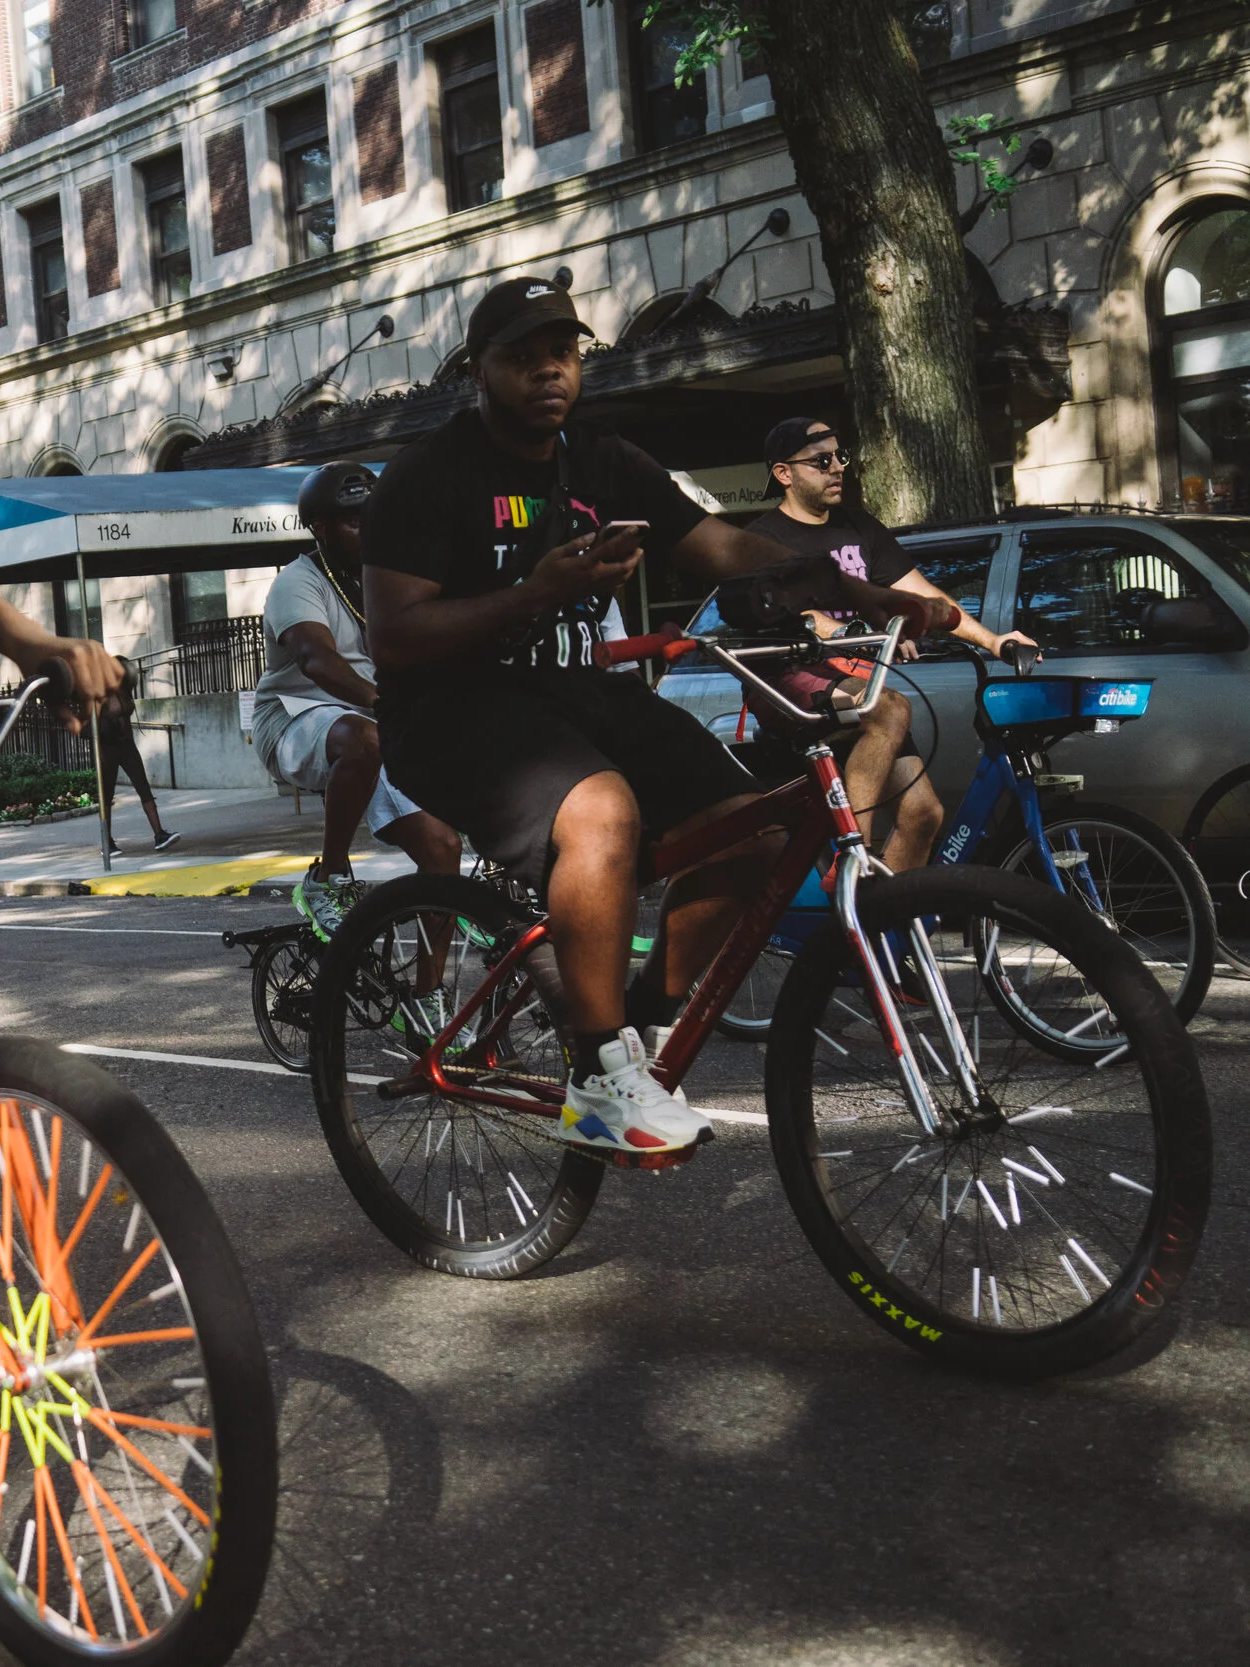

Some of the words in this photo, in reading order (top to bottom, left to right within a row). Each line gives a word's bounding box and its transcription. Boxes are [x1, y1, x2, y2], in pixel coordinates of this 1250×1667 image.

[695, 488, 736, 504] Warren
[96, 523, 131, 541] 1184
[231, 516, 277, 534] Kravis
[848, 1271, 943, 1342] MAXXIS
